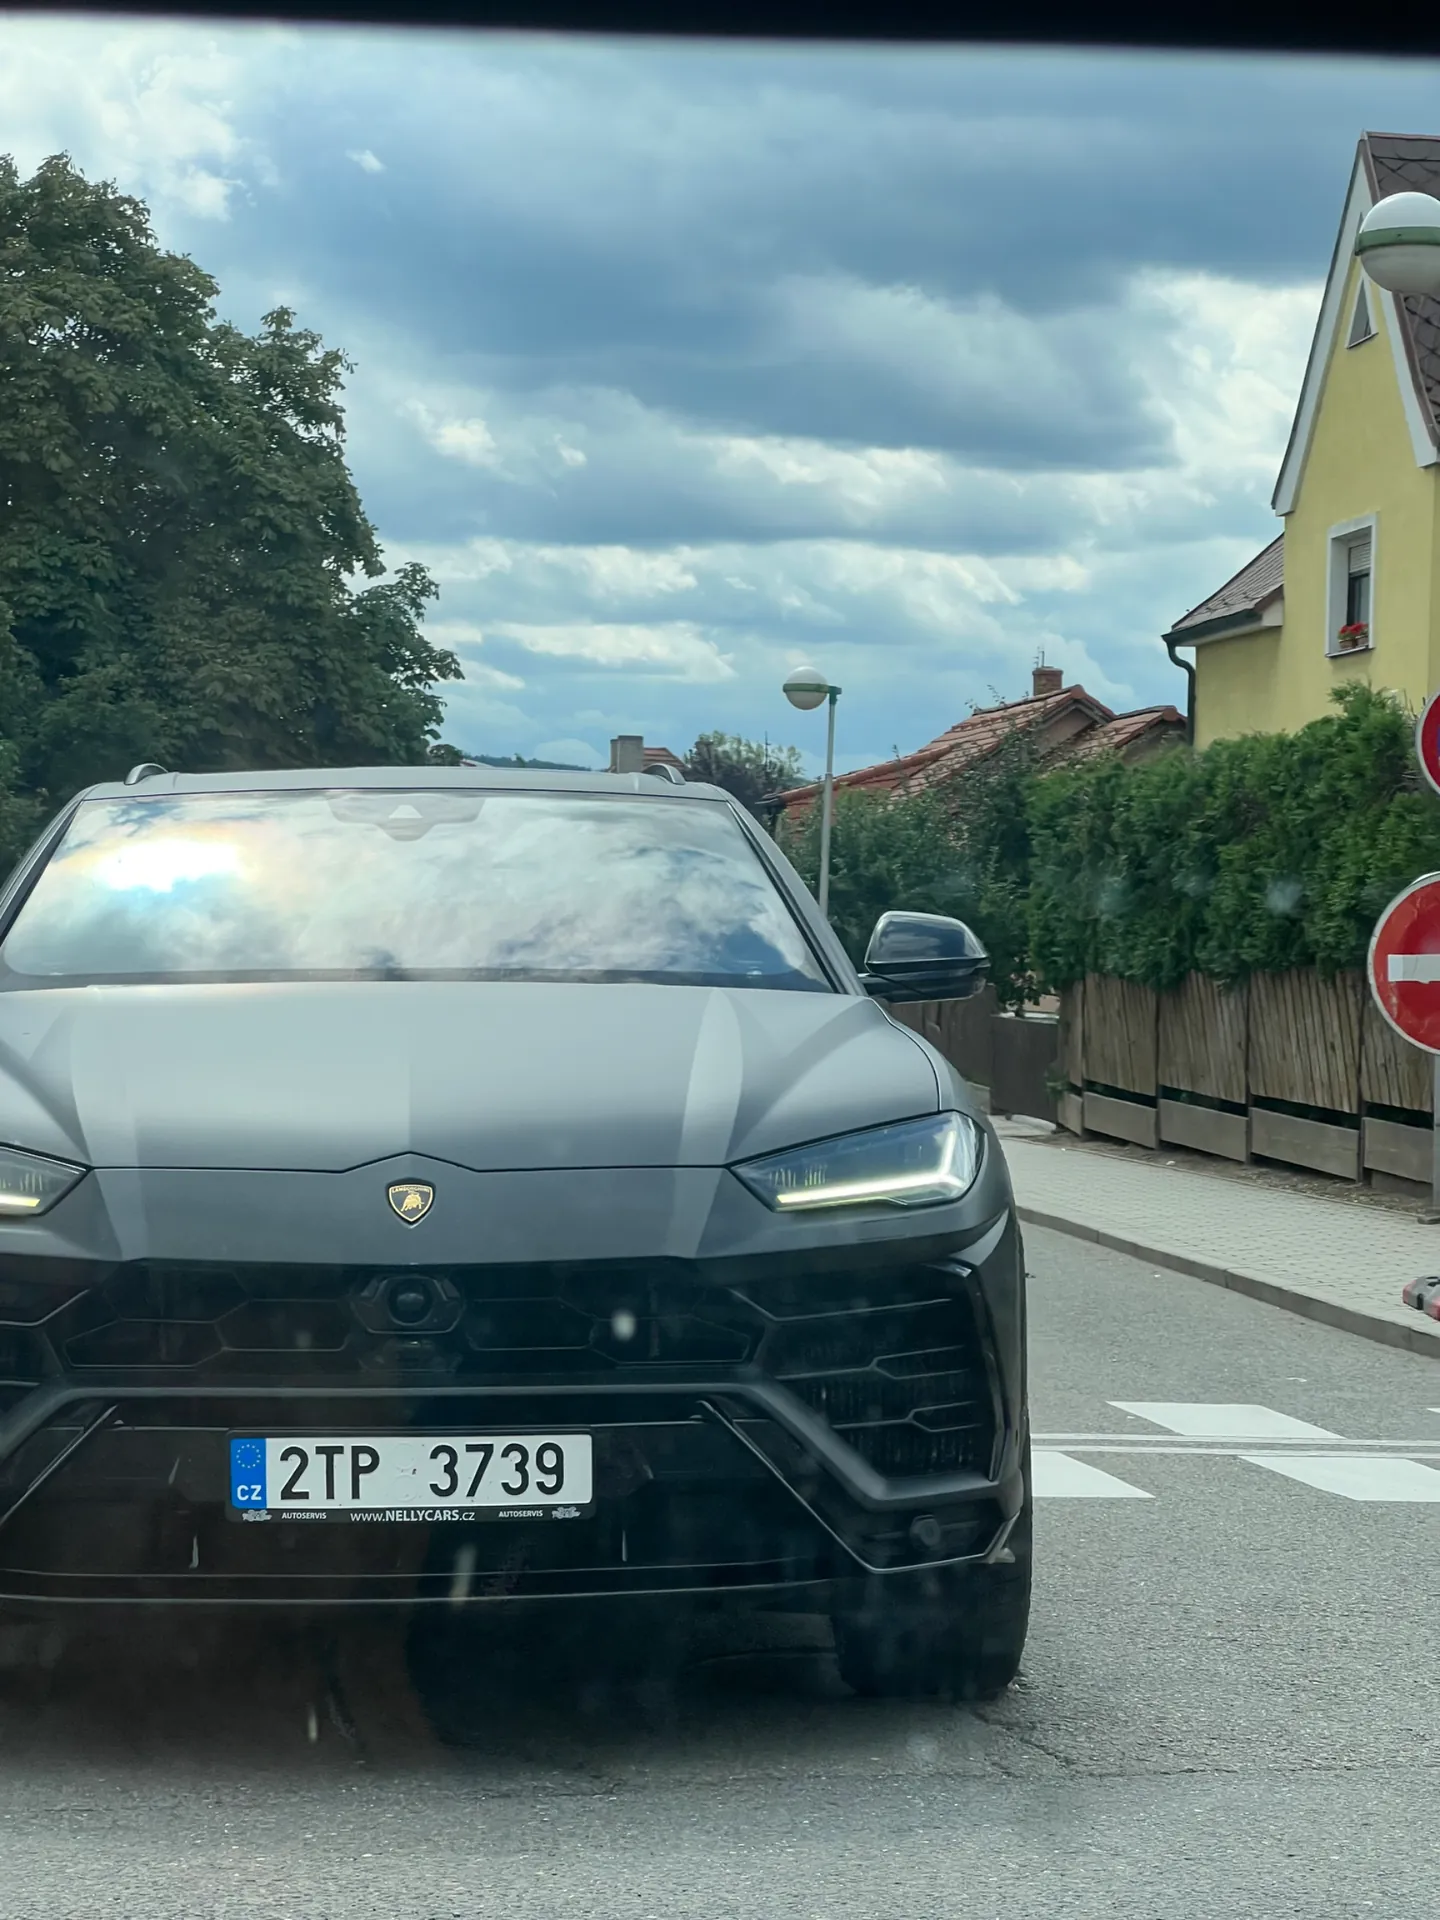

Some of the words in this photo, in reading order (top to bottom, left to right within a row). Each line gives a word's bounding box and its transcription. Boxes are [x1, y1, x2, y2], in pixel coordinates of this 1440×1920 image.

[280, 1446, 379, 1500] 2TP
[429, 1442, 564, 1497] 3739
[237, 1485, 261, 1500] CZ
[281, 1512, 327, 1520] AUTOSERVIS
[499, 1510, 543, 1518] AUTOSERVIS
